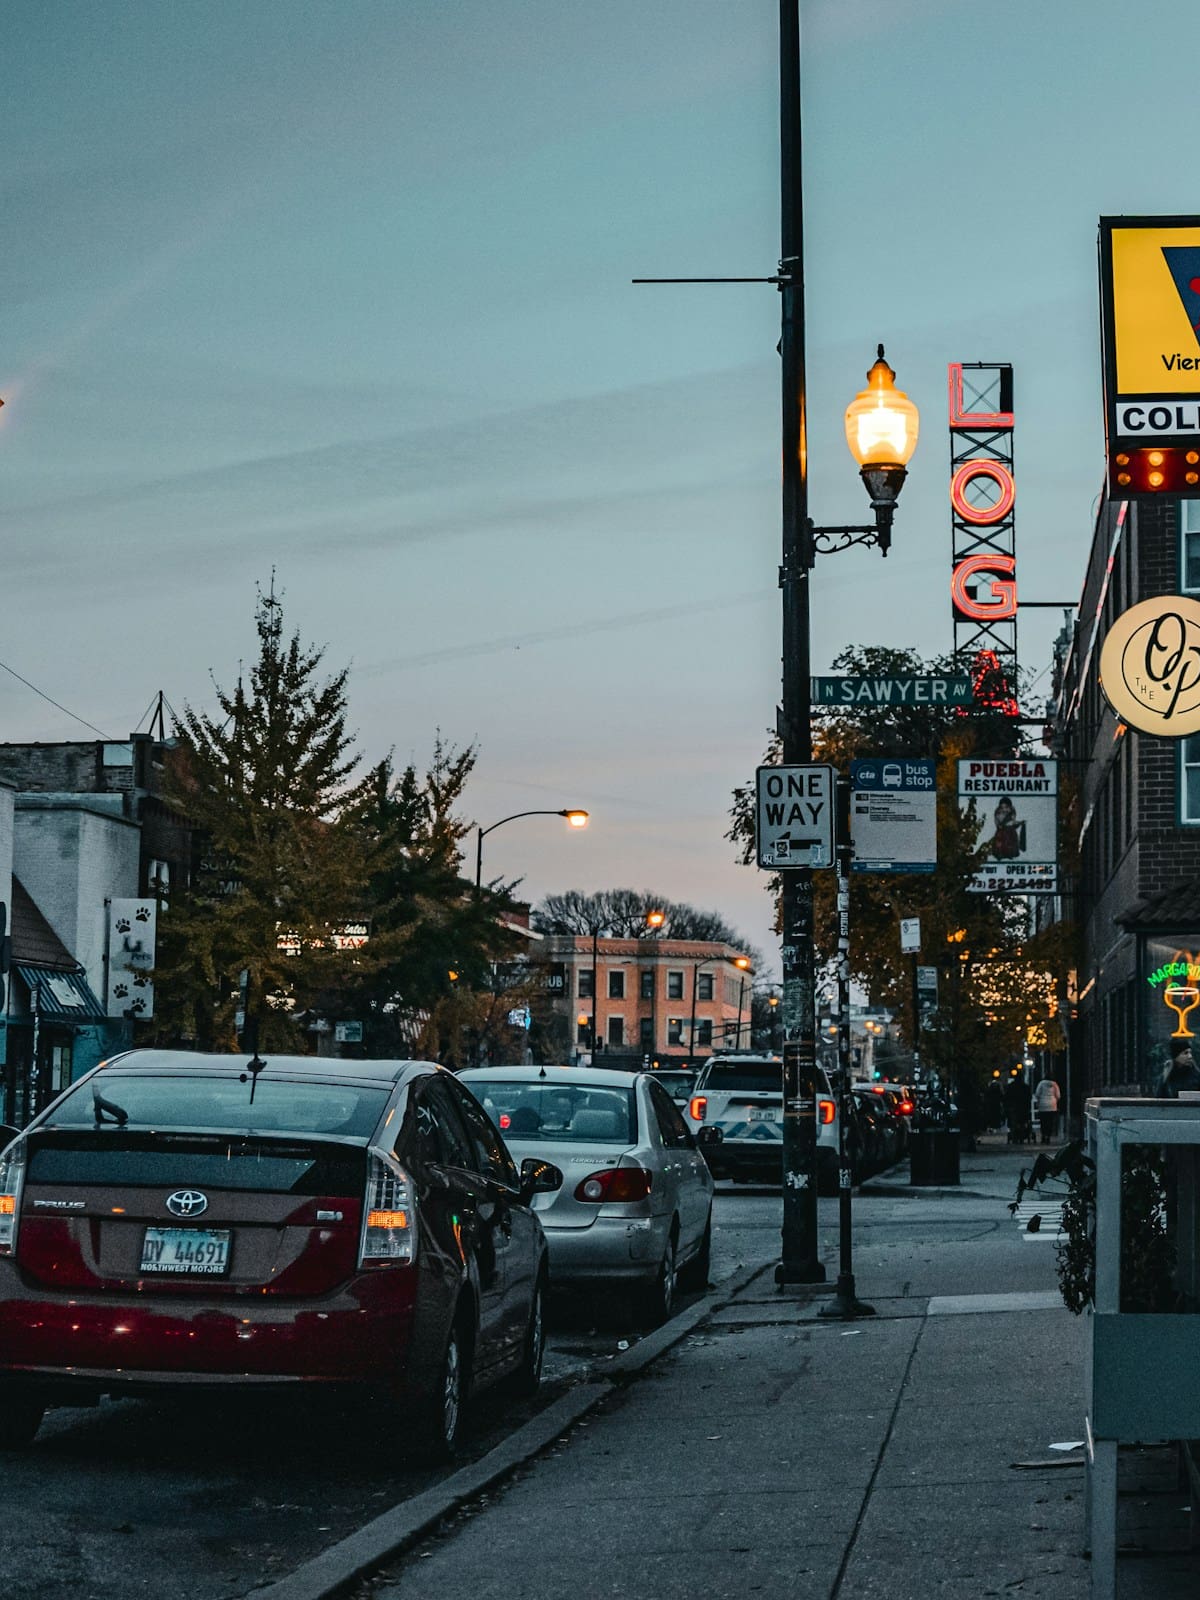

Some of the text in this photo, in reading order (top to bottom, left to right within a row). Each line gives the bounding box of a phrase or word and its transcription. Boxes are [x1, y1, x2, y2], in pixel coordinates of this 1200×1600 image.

[825, 680, 967, 701] N SAWYER AV
[1135, 676, 1155, 702] THE
[859, 771, 876, 779] cta
[905, 763, 929, 775] bus
[970, 763, 1046, 777] PUEBLA
[766, 774, 823, 798] ONE
[905, 776, 933, 788] stop
[964, 779, 1051, 792] RESTAURANT
[765, 802, 824, 827] WAY
[1006, 865, 1026, 875] OPEN
[33, 1200, 86, 1209] PRIUS
[174, 1241, 225, 1264] 44691
[140, 1263, 224, 1273] NORTHWEST MOTORS
